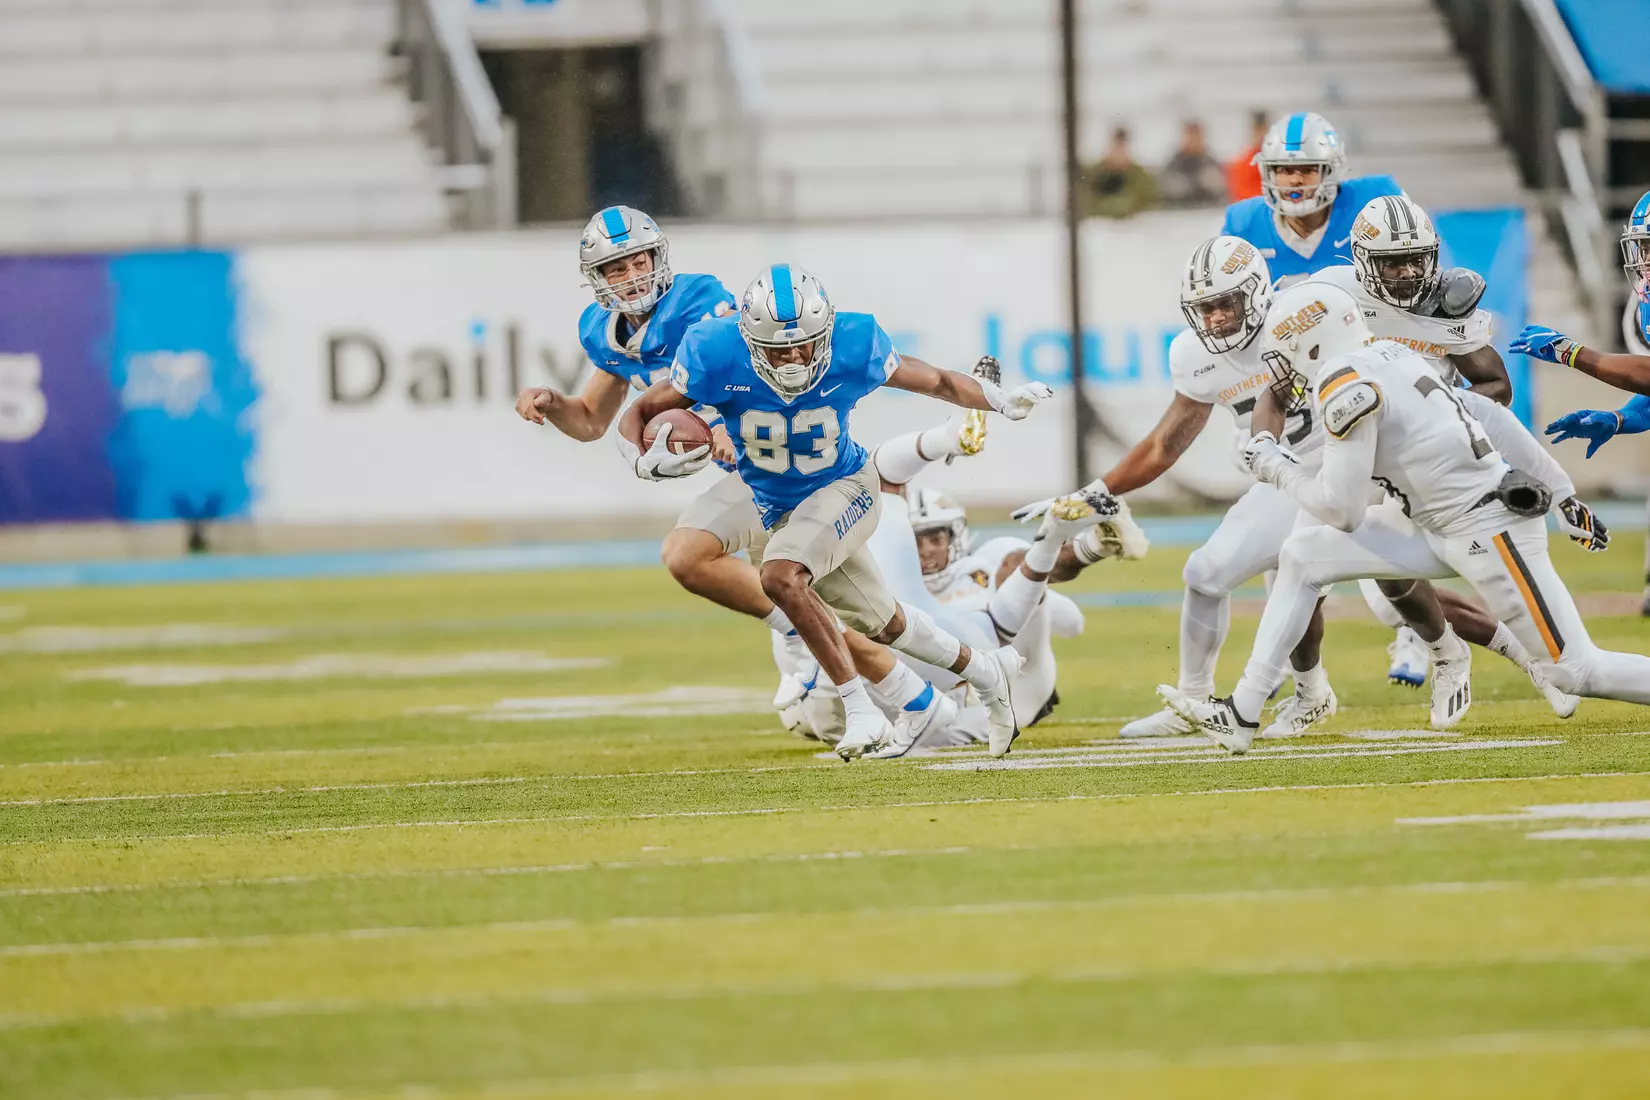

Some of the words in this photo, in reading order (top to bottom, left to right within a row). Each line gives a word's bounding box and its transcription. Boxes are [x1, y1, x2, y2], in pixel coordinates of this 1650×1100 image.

[1272, 301, 1327, 340] SOUTHERN
[326, 320, 587, 406] Daily
[1217, 371, 1272, 404] SOUTHERN
[740, 406, 840, 475] 83
[834, 490, 873, 540] RAIDERS
[1200, 721, 1235, 735] adidas
